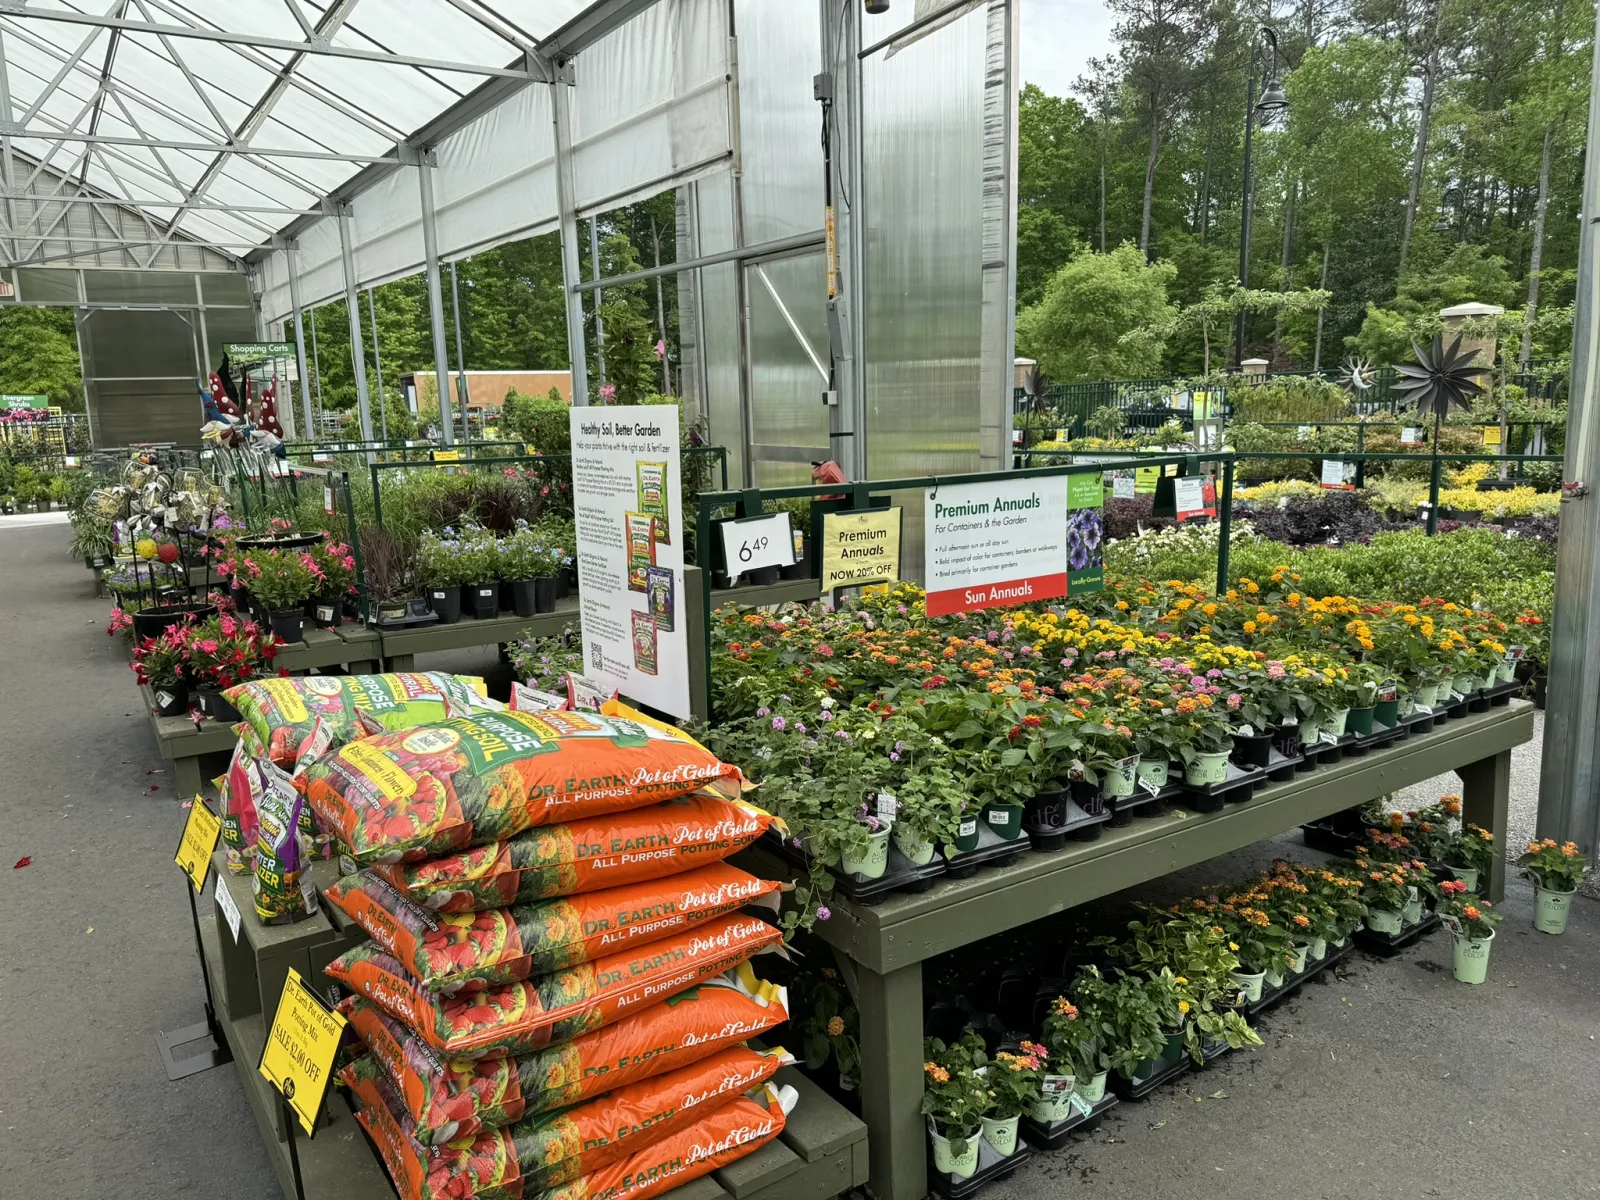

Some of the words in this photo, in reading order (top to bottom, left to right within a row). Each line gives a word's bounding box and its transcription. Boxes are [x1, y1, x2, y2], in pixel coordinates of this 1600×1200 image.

[230, 344, 267, 354] Shopping
[581, 422, 600, 438] Healthy
[602, 422, 614, 437] Soil,
[616, 423, 632, 436] Better
[634, 422, 660, 436] Garden
[935, 500, 989, 519] Premium
[993, 492, 1041, 513] Annuals
[839, 529, 887, 543] Premium
[935, 524, 946, 534] For
[948, 520, 982, 532] Containers
[984, 520, 990, 528] &
[992, 518, 1002, 527] the
[1002, 515, 1027, 526] Garden
[841, 544, 884, 559] Annuals
[951, 556, 966, 564] impact
[1038, 544, 1058, 552] walkways
[830, 570, 854, 580] NOW
[857, 566, 874, 578] 20%
[876, 564, 892, 574] OFF
[951, 567, 972, 578] primarily
[980, 564, 1000, 572] container
[1001, 562, 1018, 570] gardens
[965, 590, 986, 604] Sun
[989, 580, 1033, 601] Annuals
[354, 692, 374, 711] MIX
[577, 694, 588, 706] DR.
[478, 712, 543, 752] PURPOSE
[480, 733, 509, 762] SOIL
[528, 784, 562, 800] DR.
[565, 775, 626, 793] EARTH
[630, 767, 660, 785] Pot
[662, 765, 678, 783] of
[678, 762, 721, 780] Gold
[545, 796, 572, 808] ALL
[574, 788, 633, 803] PURPOSE
[637, 781, 690, 794] POTTING
[694, 776, 719, 788] SOIL
[577, 843, 609, 858] DR.
[611, 834, 670, 853] EARTH
[673, 825, 704, 844] Pot
[704, 826, 720, 844] of
[719, 820, 758, 838] Gold
[592, 858, 618, 869] ALL
[621, 848, 677, 865] PURPOSE
[680, 838, 730, 855] POTTING
[733, 835, 758, 846] SOIL
[378, 912, 398, 933] EARTH
[584, 920, 617, 936] DR.
[617, 902, 676, 926] EARTH
[679, 891, 709, 910] Pot
[709, 888, 724, 904] of
[723, 880, 762, 898] Gold
[422, 914, 440, 932] QUARTS
[601, 932, 626, 946] ALL
[629, 915, 683, 938] PURPOSE
[686, 902, 736, 922] POTTING
[598, 971, 629, 988] DR.
[628, 948, 686, 976] EARTH
[688, 937, 716, 956] Pot
[716, 930, 731, 947] of
[728, 920, 766, 940] Gold
[617, 994, 641, 1008] ALL
[644, 971, 696, 998] PURPOSE
[698, 953, 743, 977] POTTING
[745, 944, 768, 956] SOIL
[286, 981, 295, 996] Dr.
[295, 989, 308, 1010] Earth
[307, 1004, 318, 1018] Pot
[316, 1012, 323, 1024] of
[322, 1016, 336, 1036] Gold
[291, 1007, 309, 1034] Potting
[308, 1027, 318, 1042] Mix
[274, 1024, 290, 1052] SALE
[289, 1040, 306, 1069] $2.00
[304, 1057, 321, 1083] OFF
[618, 1044, 676, 1070] EARTH
[680, 1032, 708, 1049] Pot
[726, 1017, 768, 1036] Gold
[618, 1108, 676, 1138] EARTH
[679, 1094, 706, 1112] Pot
[724, 1064, 765, 1090] Gold
[622, 1155, 683, 1188] EARTH
[686, 1144, 716, 1164] Pot
[716, 1138, 735, 1153] of
[731, 1119, 774, 1144] Gold
[949, 1158, 974, 1166] COLOR
